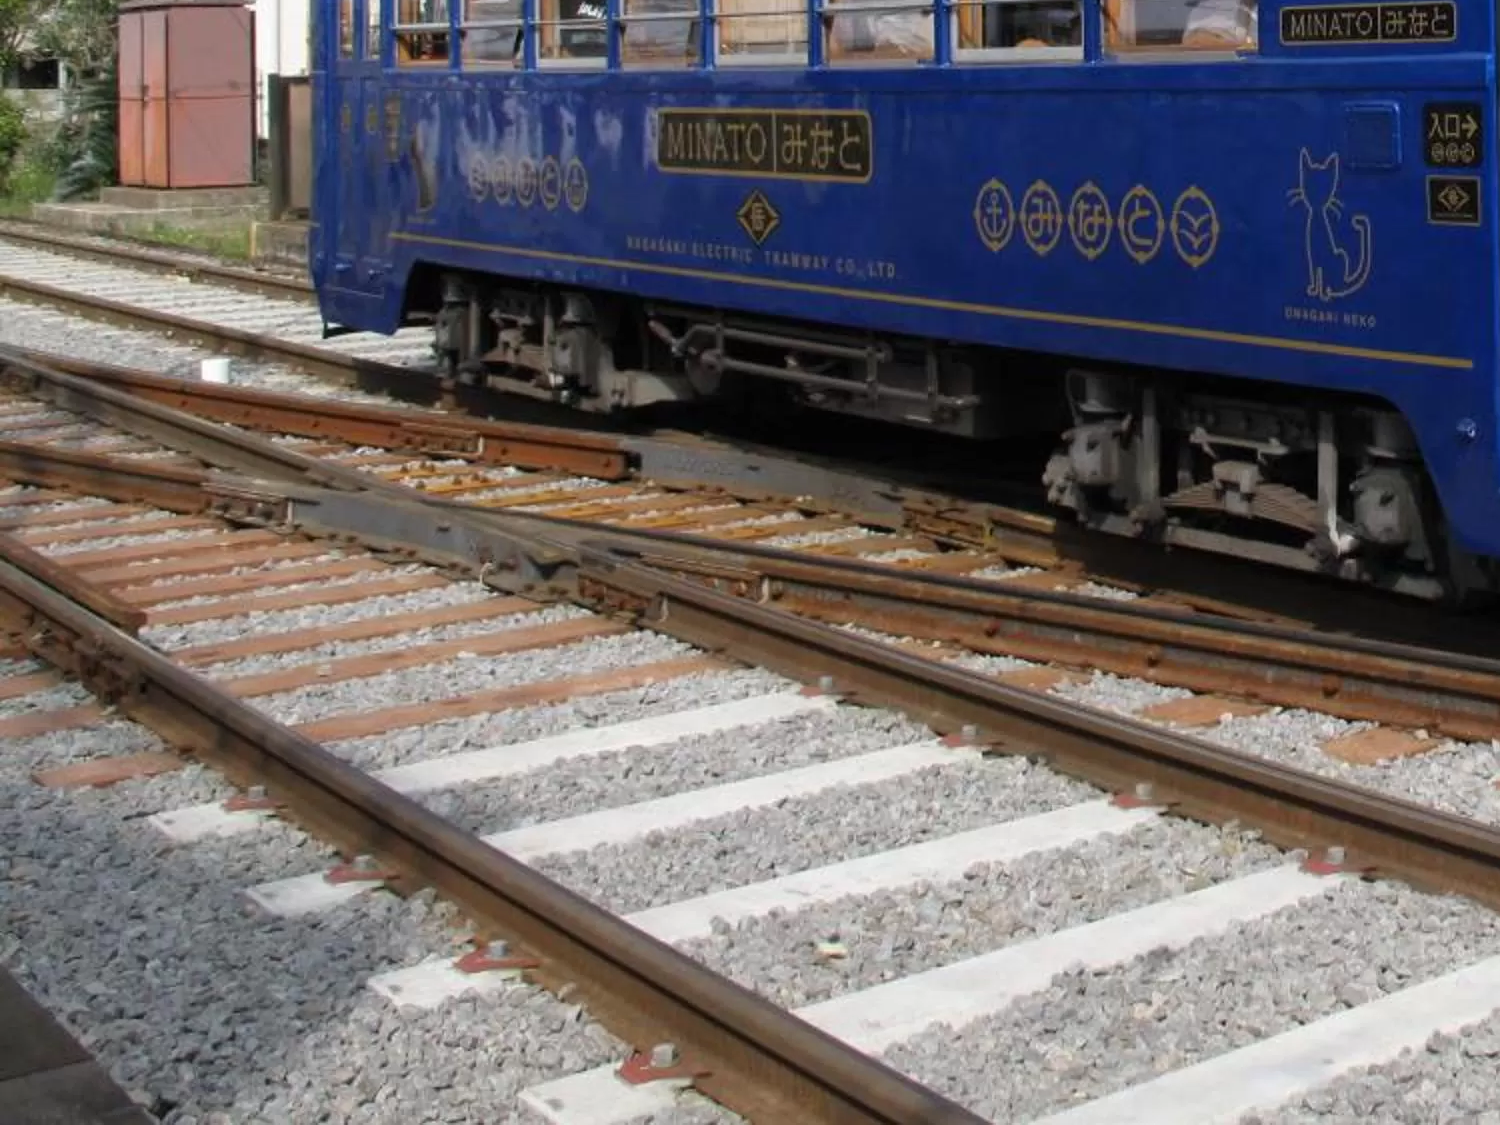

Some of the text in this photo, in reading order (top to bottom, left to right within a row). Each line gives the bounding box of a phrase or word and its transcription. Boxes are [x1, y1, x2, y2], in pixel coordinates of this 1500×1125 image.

[1290, 6, 1449, 38] MINATO みなと
[1428, 112, 1460, 139] 入口
[667, 120, 862, 171] MINATO みなと
[626, 234, 687, 254] NAGASAKI
[692, 242, 753, 263] ELECTRIC
[764, 249, 829, 271] TRAMWAY
